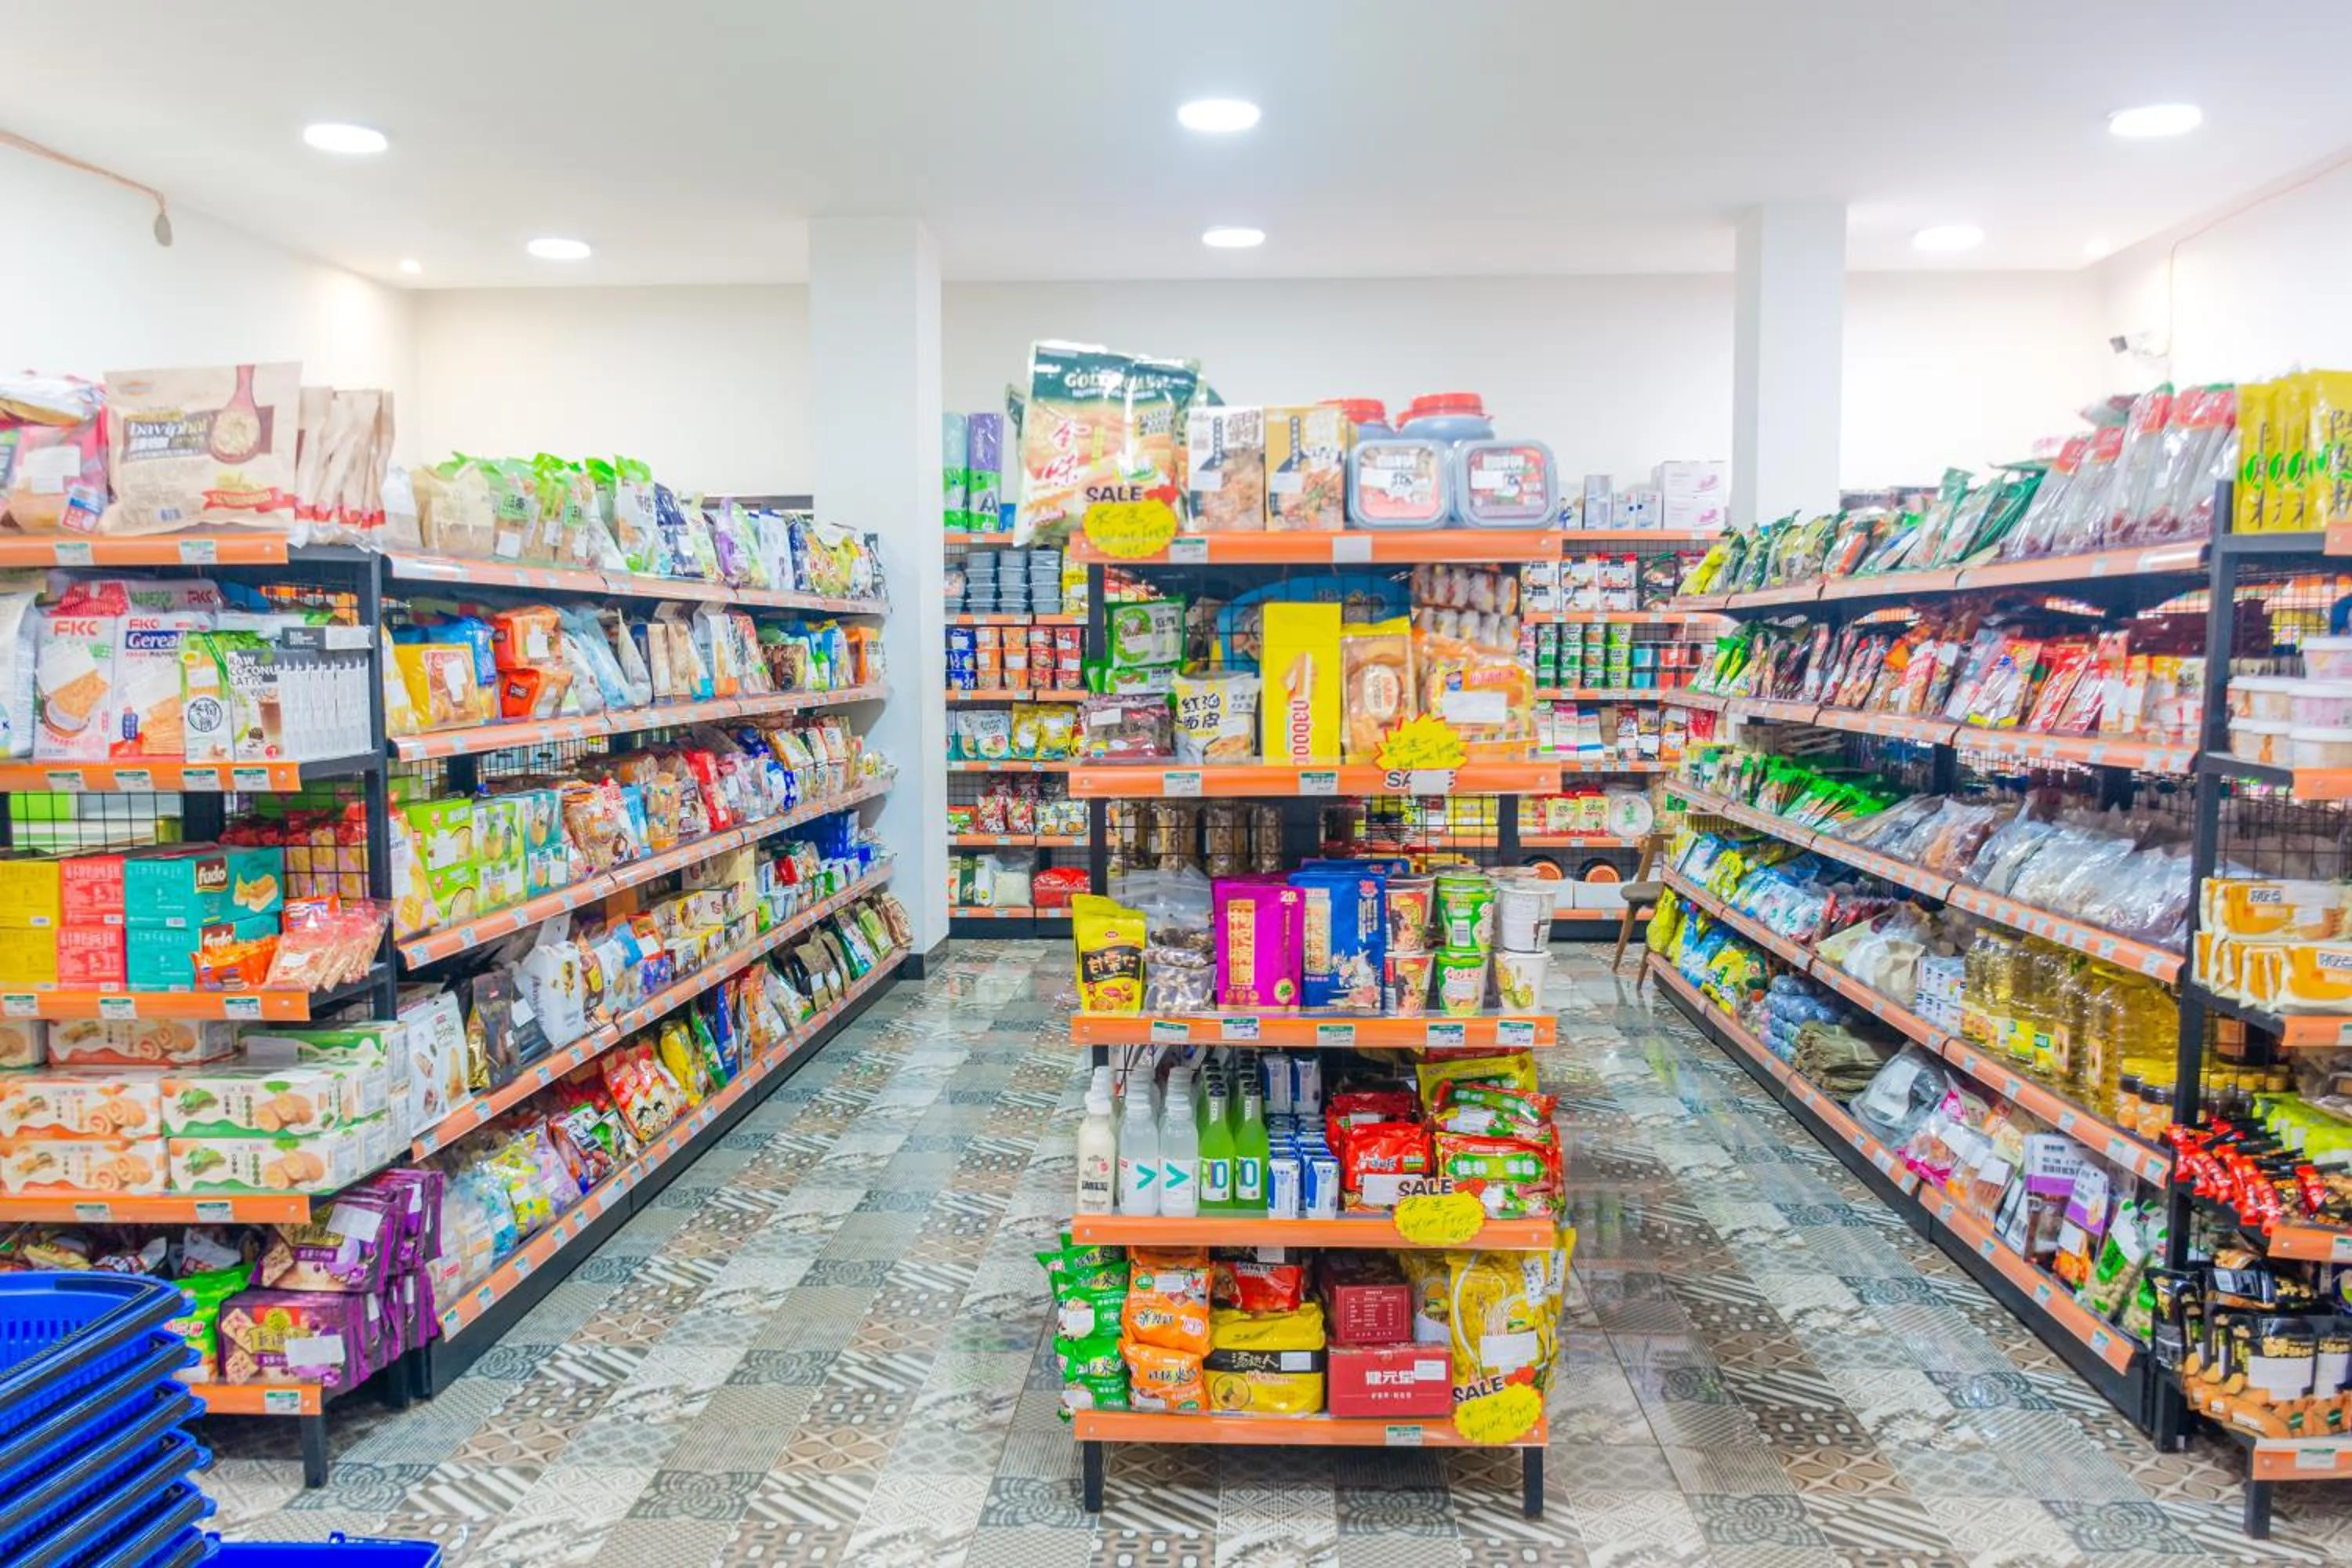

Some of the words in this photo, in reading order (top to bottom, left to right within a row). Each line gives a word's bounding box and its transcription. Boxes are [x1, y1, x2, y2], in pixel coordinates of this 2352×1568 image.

[1086, 486, 1142, 502] SALE
[53, 621, 99, 636] FKC
[228, 655, 256, 666] RAW
[228, 664, 278, 676] COCONU
[198, 866, 226, 884] fudo
[1398, 1179, 1453, 1196] SALE
[1452, 1376, 1504, 1402] SALE
